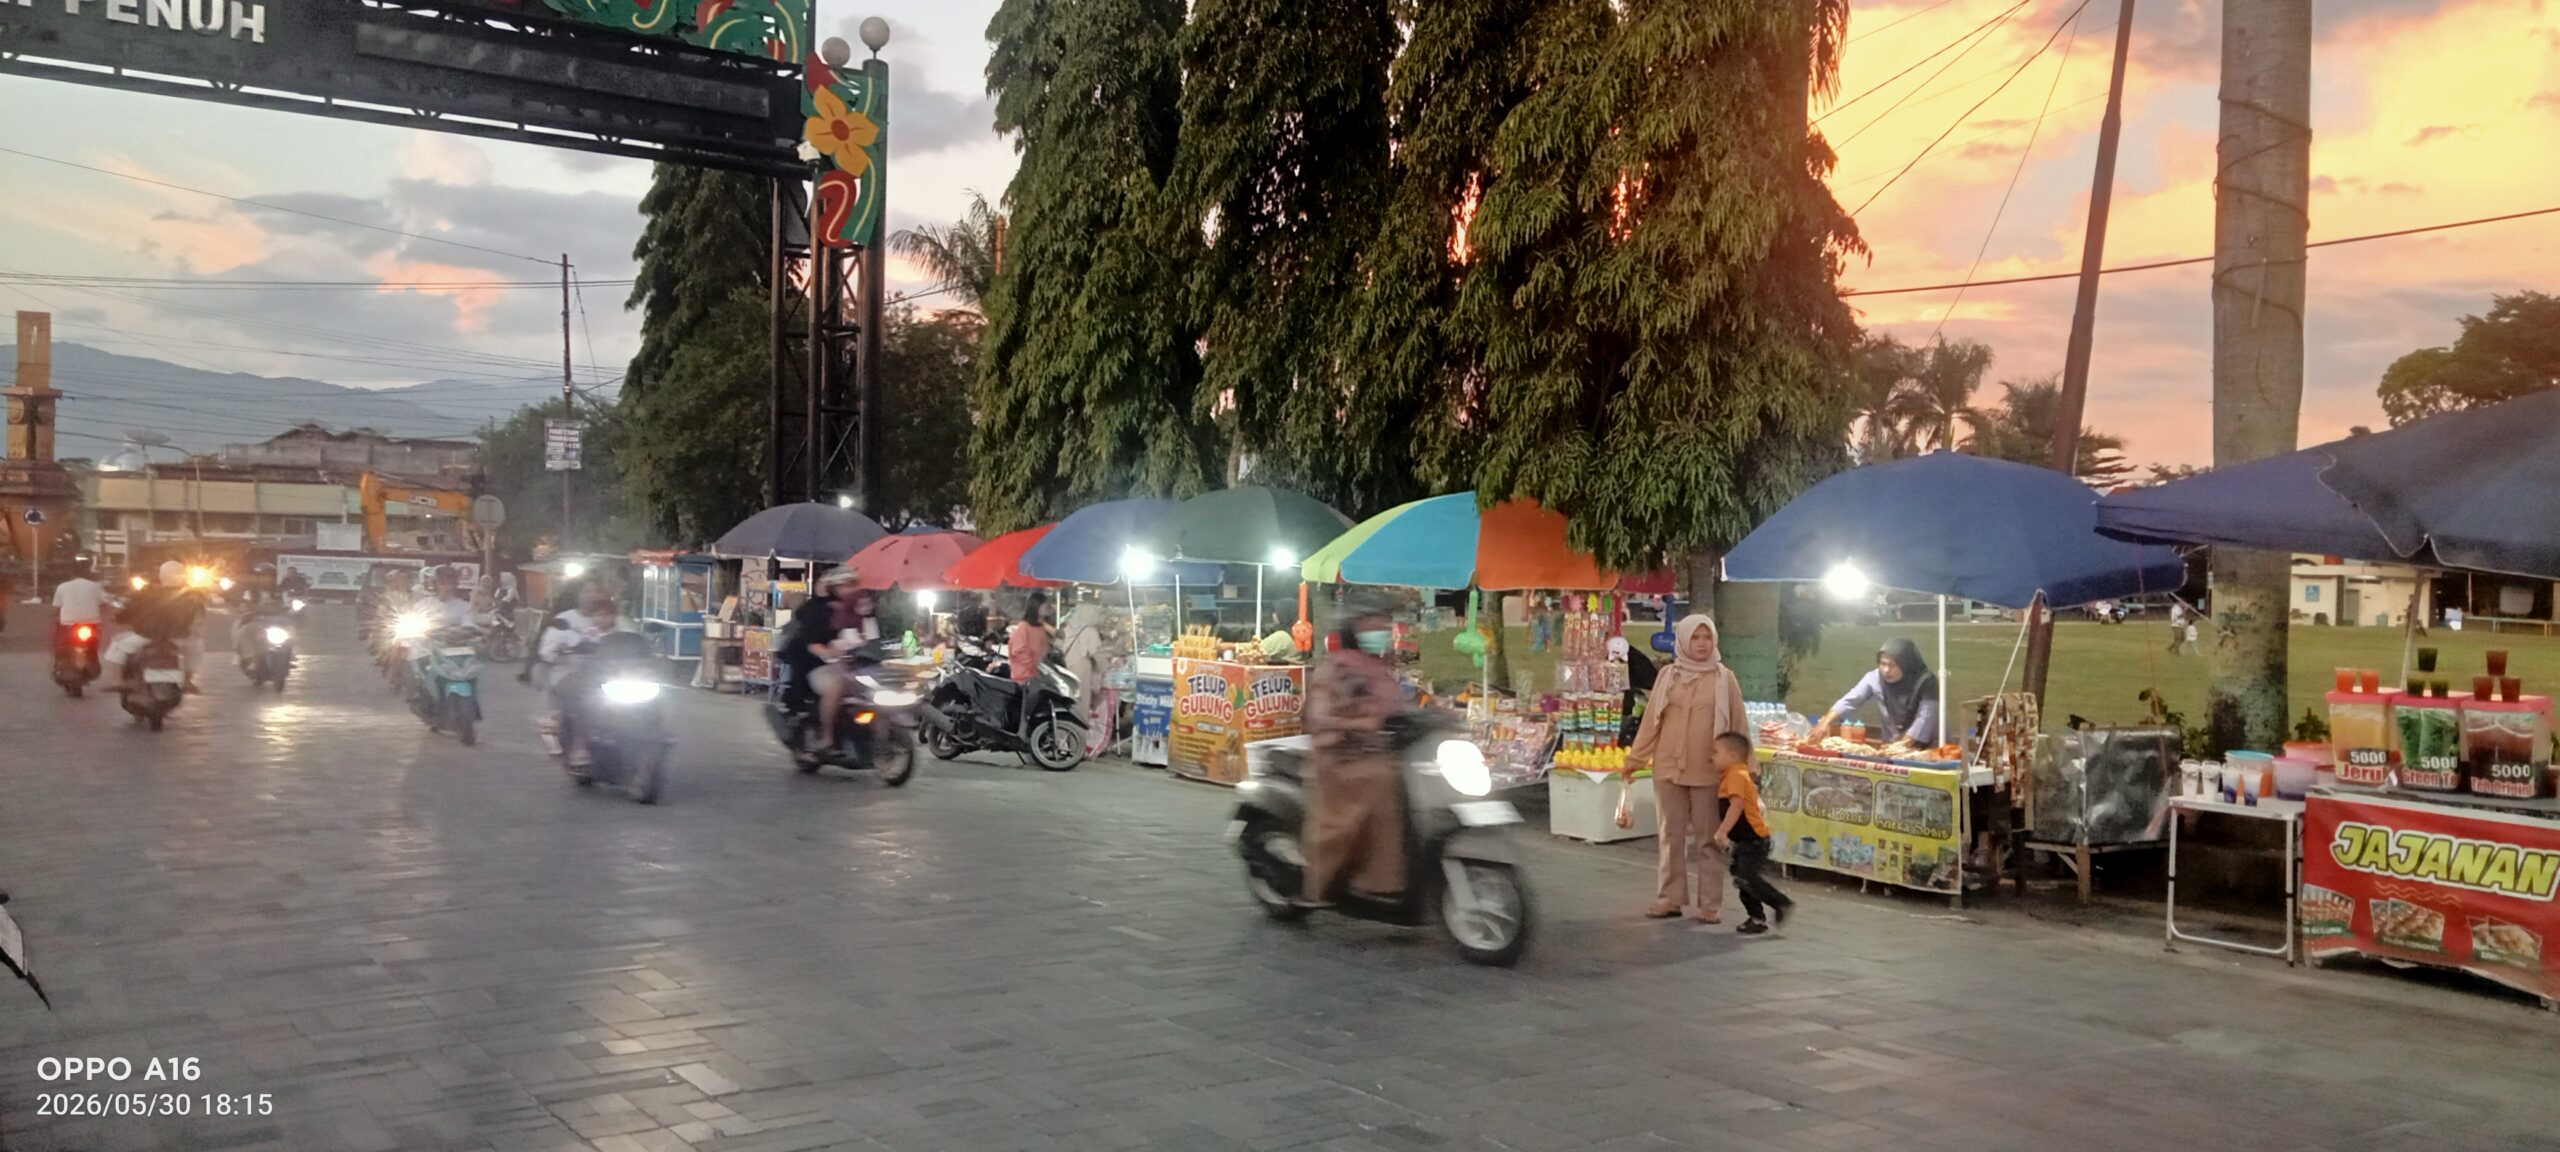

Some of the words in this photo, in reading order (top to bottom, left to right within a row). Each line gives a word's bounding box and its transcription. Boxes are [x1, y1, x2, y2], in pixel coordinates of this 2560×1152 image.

[1187, 674, 1228, 697] TELUR
[1251, 678, 1292, 698] TELUR
[1180, 695, 1233, 723] GULUNG
[1245, 696, 1301, 718] GULUNG
[2350, 751, 2387, 765] 5000
[2420, 756, 2458, 770] 5000
[2491, 764, 2530, 778] 5000
[1876, 814, 1911, 832] Aneka
[1915, 823, 1950, 840] Sosis
[2331, 823, 2560, 900] JAJANAN
